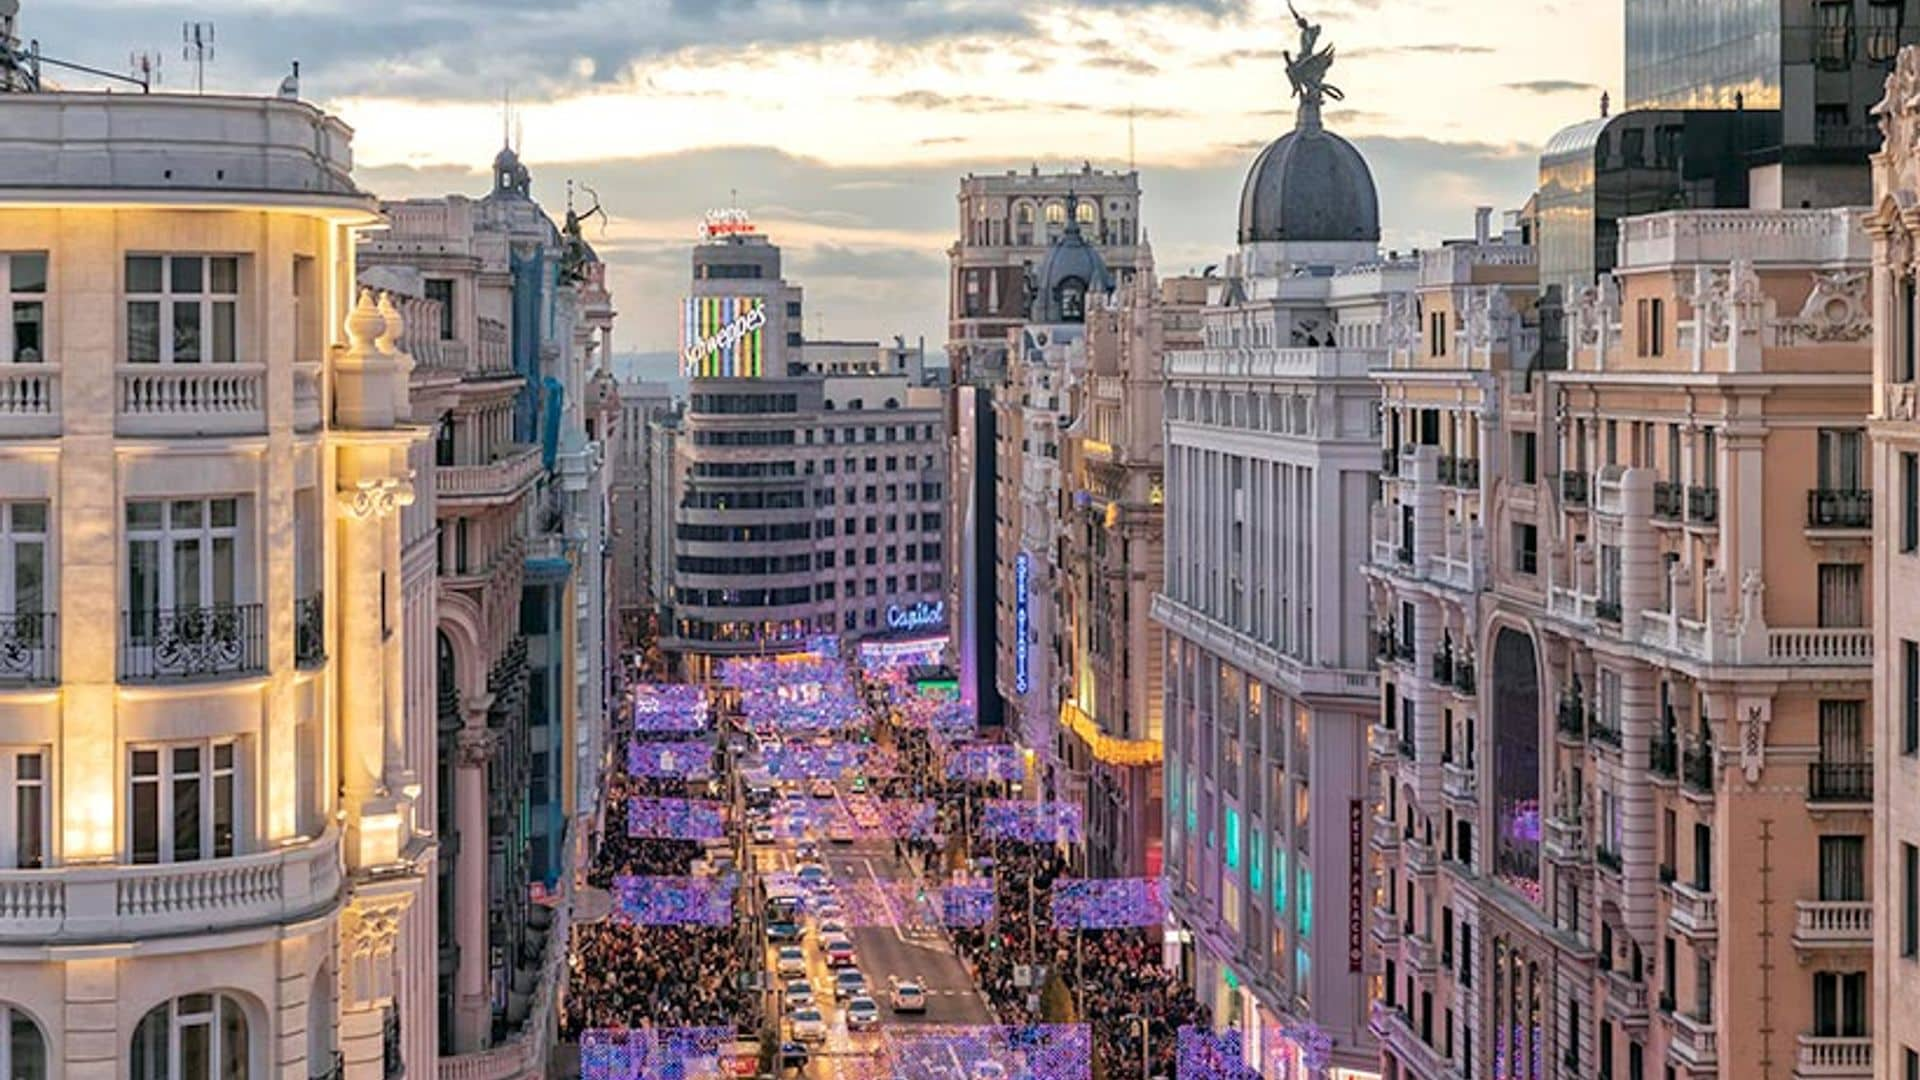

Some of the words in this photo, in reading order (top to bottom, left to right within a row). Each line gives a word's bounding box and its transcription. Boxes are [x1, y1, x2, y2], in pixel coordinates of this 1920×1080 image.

[887, 601, 944, 630] Capitol
[1352, 807, 1360, 867] PETIT
[1351, 873, 1360, 946] PALACE
